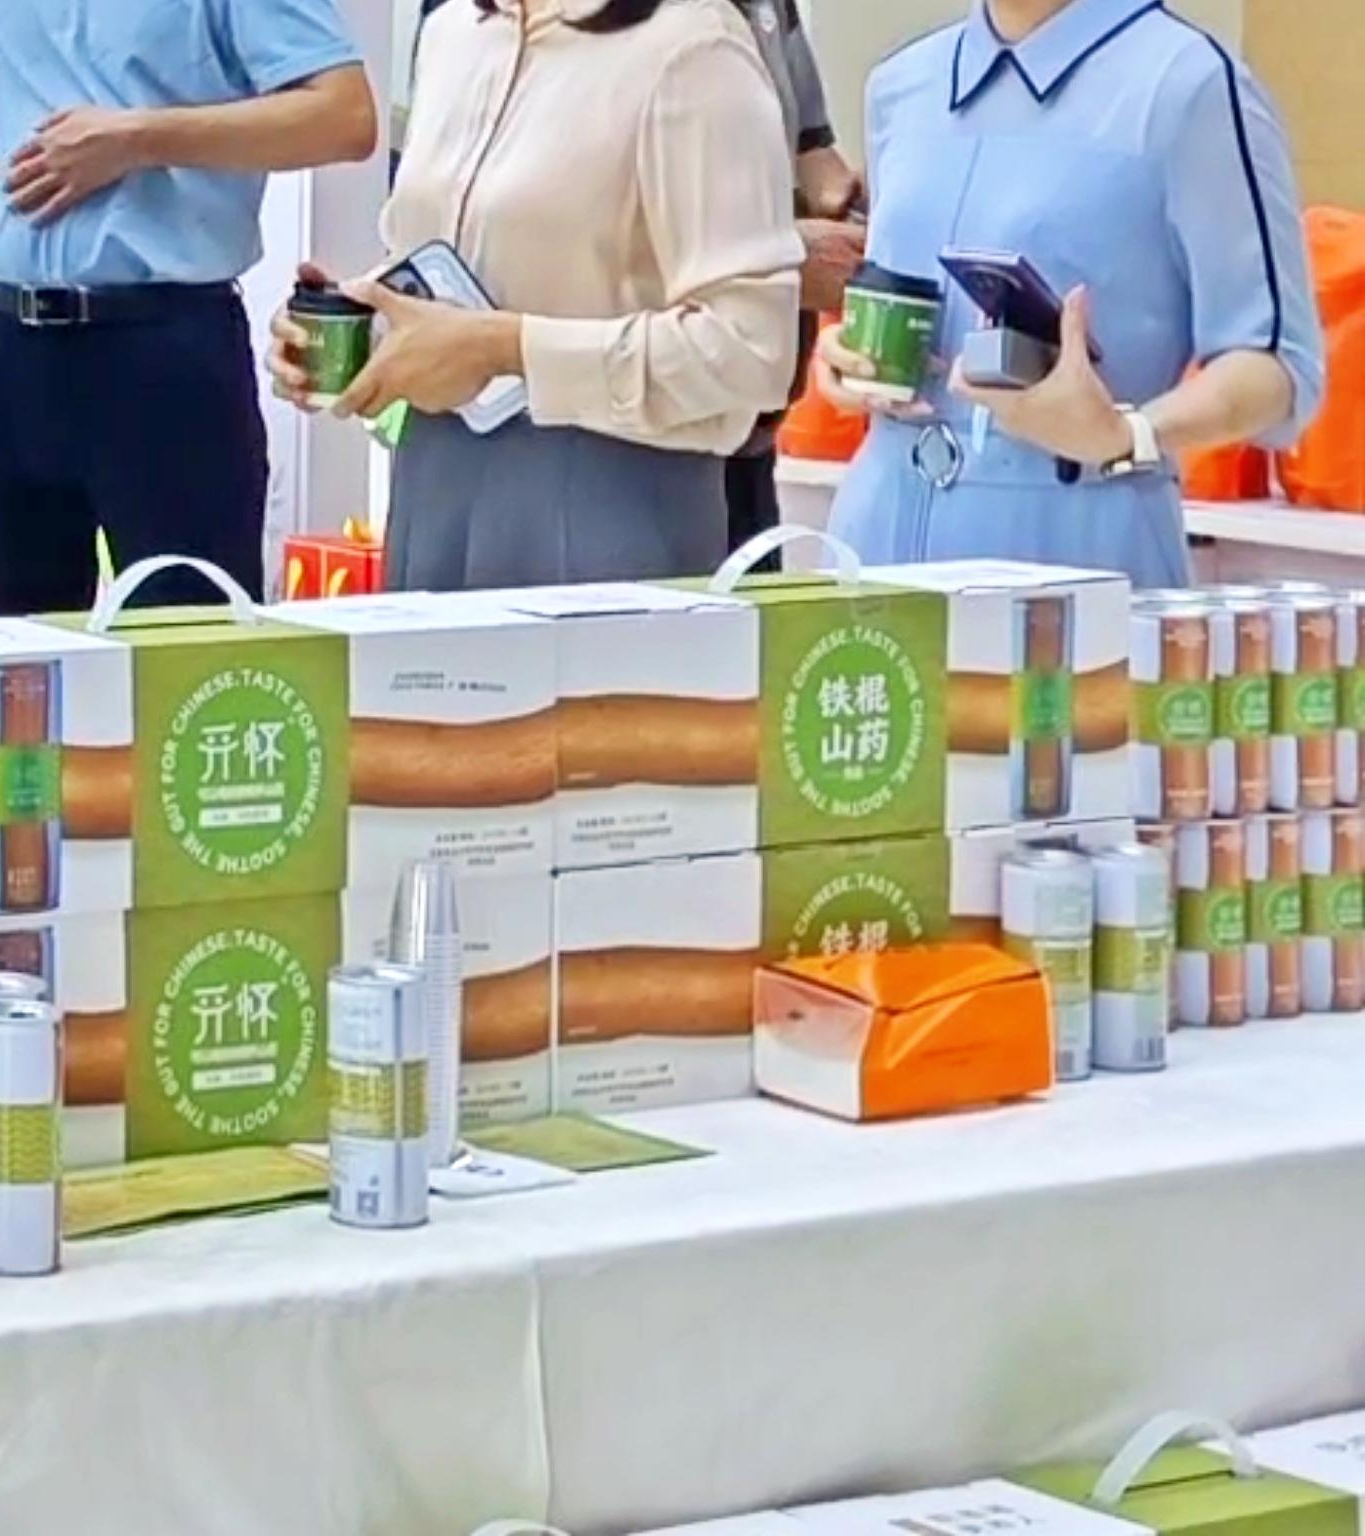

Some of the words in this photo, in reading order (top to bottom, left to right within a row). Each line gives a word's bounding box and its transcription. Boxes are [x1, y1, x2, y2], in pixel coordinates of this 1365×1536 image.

[817, 674, 890, 719] 铁棍
[197, 720, 285, 783] 开怀
[821, 716, 891, 763] 山药
[190, 981, 279, 1045] 开怀
